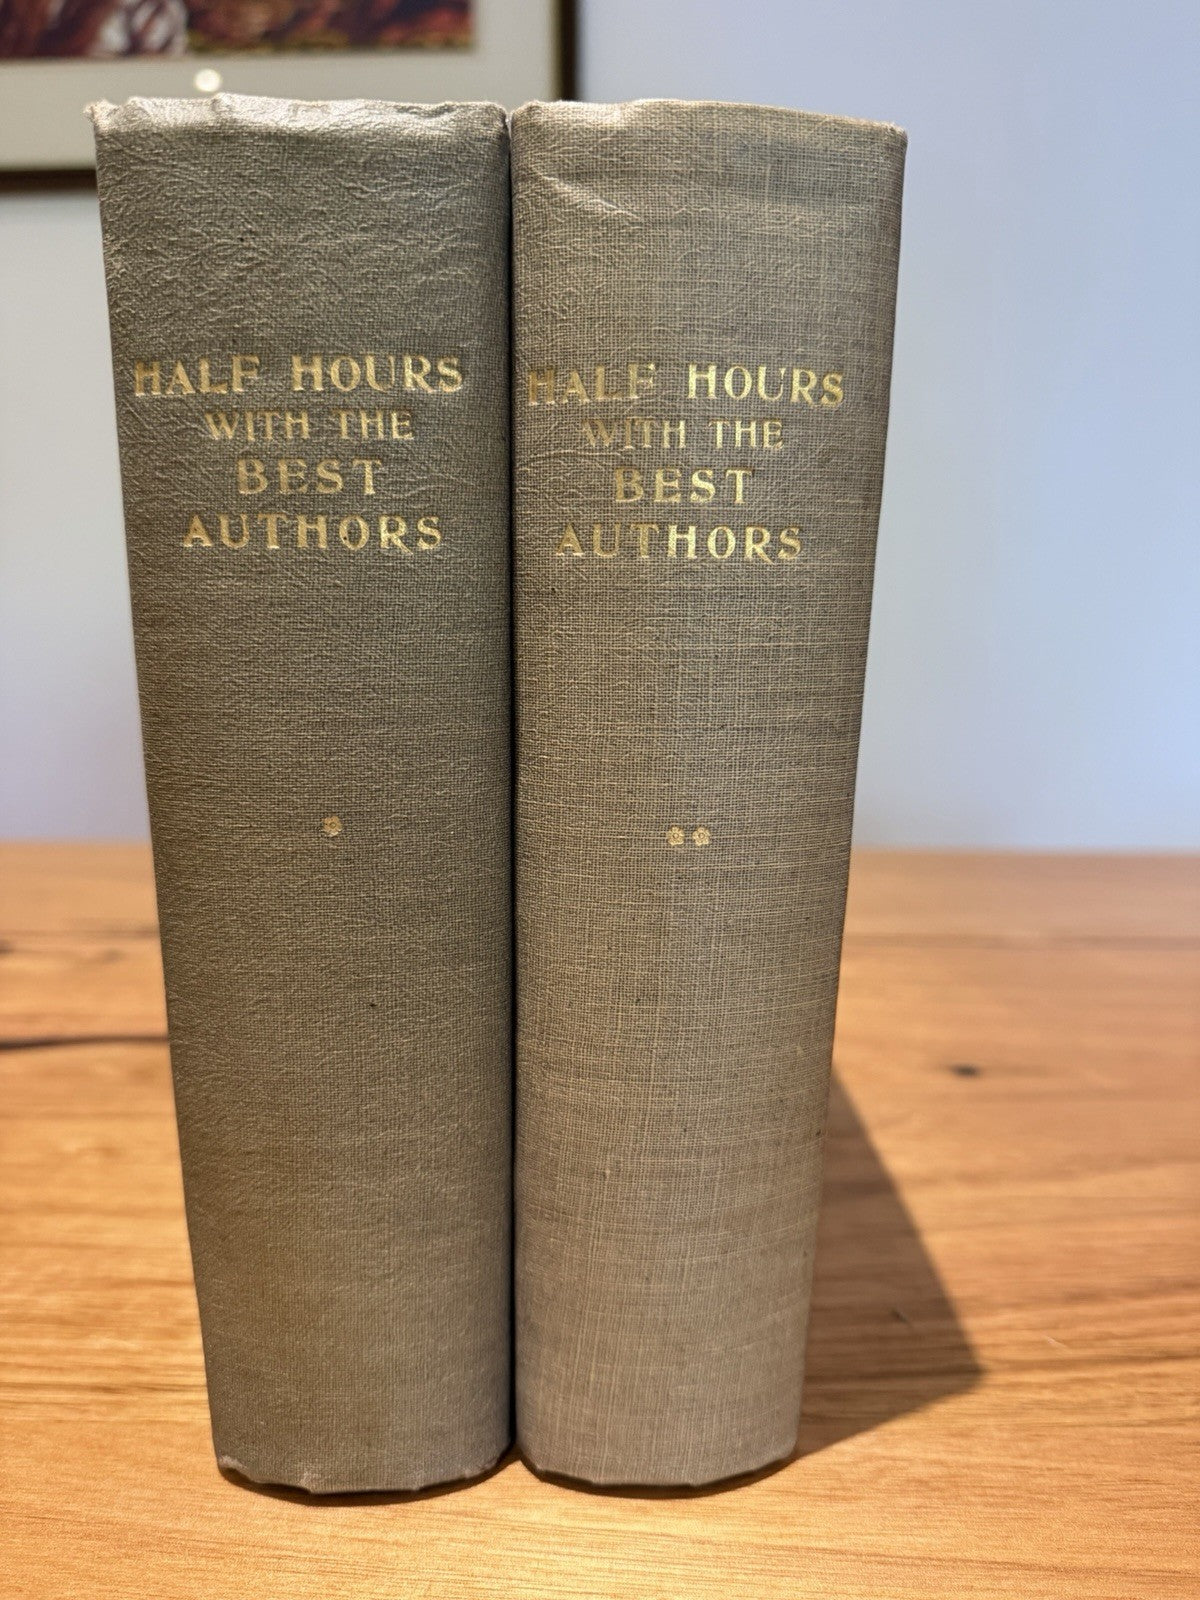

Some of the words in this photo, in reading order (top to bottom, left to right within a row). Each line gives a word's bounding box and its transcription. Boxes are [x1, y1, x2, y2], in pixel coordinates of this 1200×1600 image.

[134, 355, 260, 396] HALF
[291, 355, 463, 393] HOURS
[528, 363, 656, 406] HALF
[688, 363, 844, 408] HOURS
[204, 410, 310, 440] WITH
[333, 410, 414, 440] THE
[582, 417, 686, 449] WITH
[708, 417, 785, 449] THE
[236, 458, 382, 495] BEST
[615, 467, 754, 504] BEST
[183, 513, 442, 554] AUTHORS
[555, 523, 801, 564] AUTHORS
